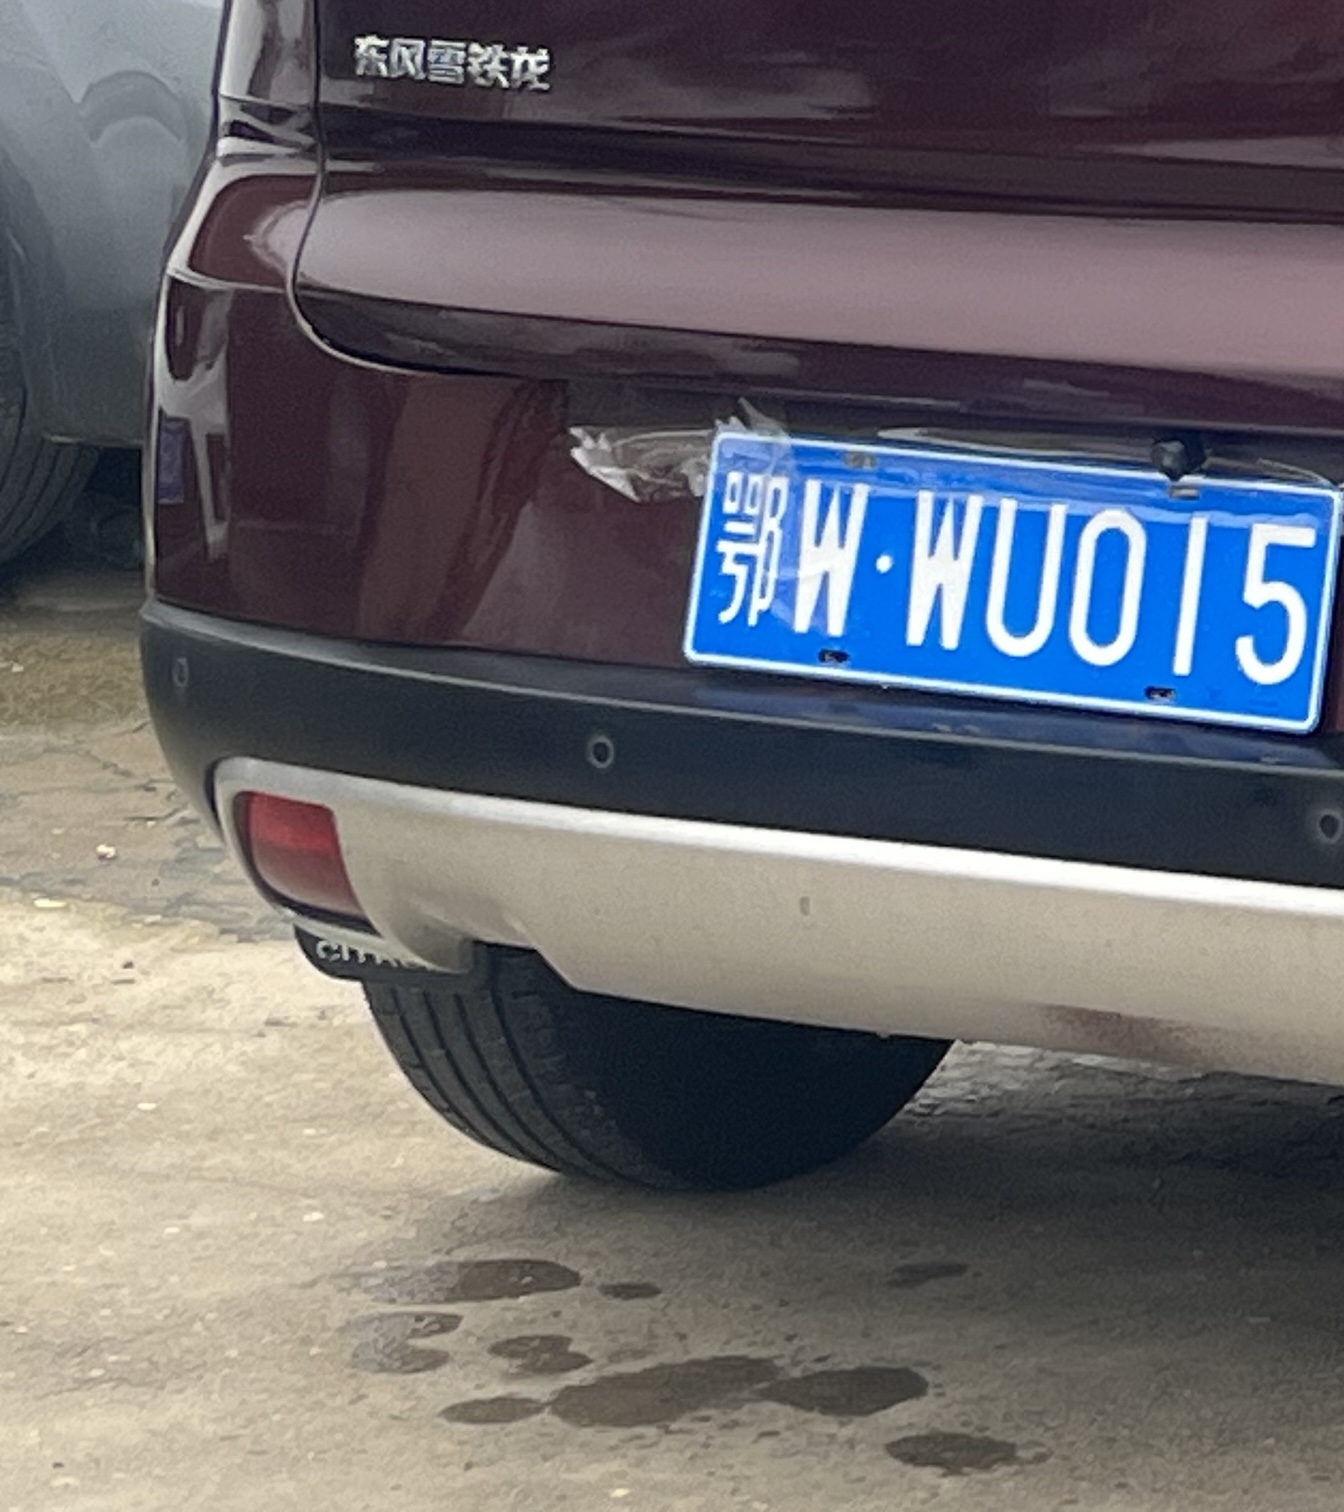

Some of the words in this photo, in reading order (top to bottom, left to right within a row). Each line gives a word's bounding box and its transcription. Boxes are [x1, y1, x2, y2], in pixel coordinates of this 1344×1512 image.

[354, 34, 550, 91] 东风雪铁龙
